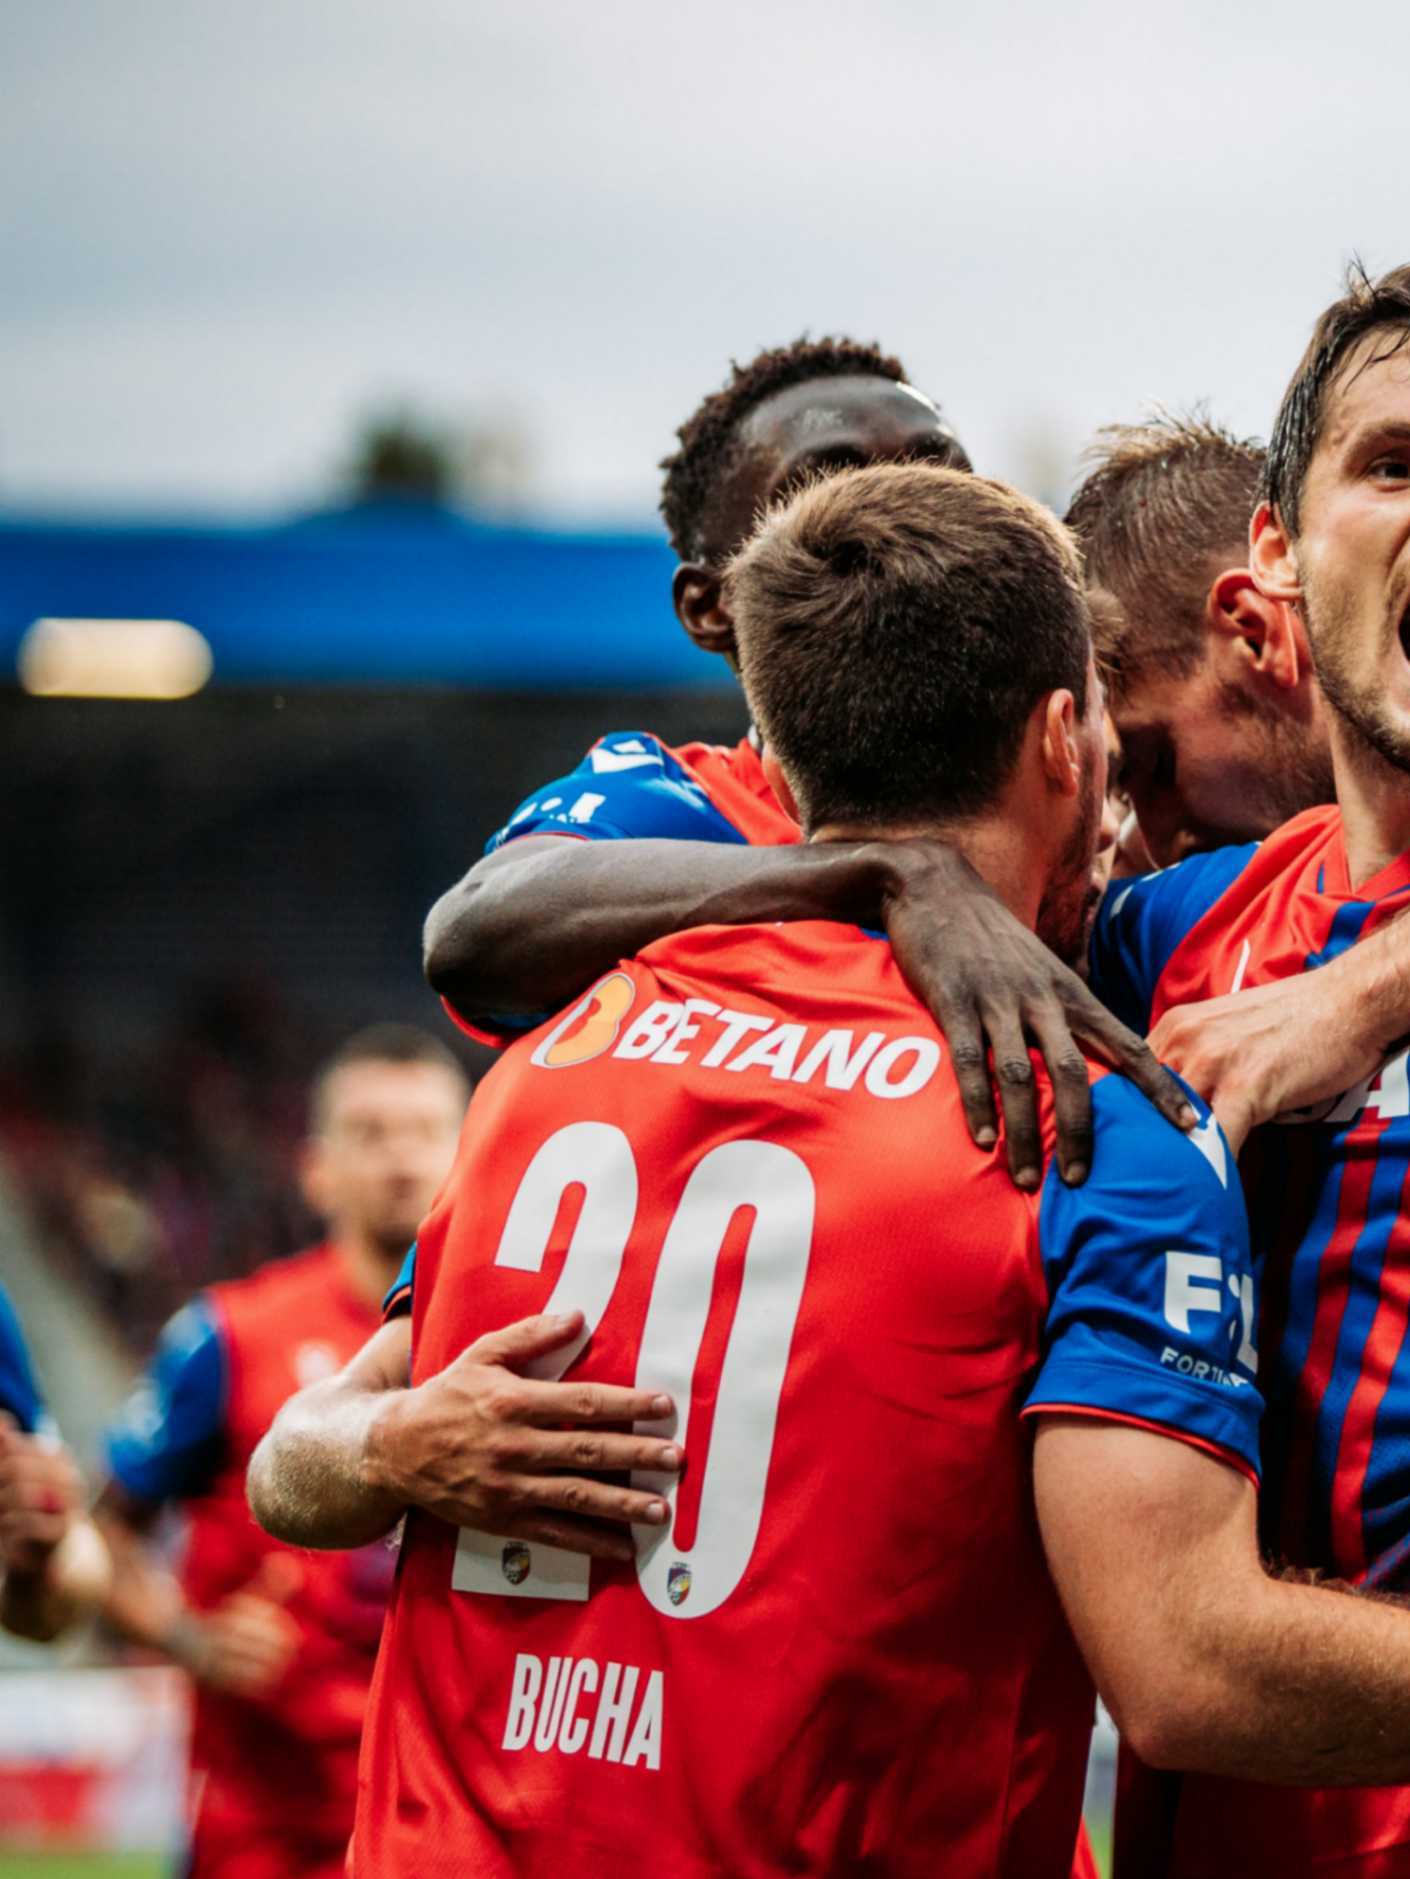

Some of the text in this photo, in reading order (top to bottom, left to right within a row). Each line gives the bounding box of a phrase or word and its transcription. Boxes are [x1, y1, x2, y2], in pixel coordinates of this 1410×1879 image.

[612, 998, 940, 1099] BETANO
[451, 1121, 817, 1620] 20
[502, 1653, 664, 1770] BUCHA
